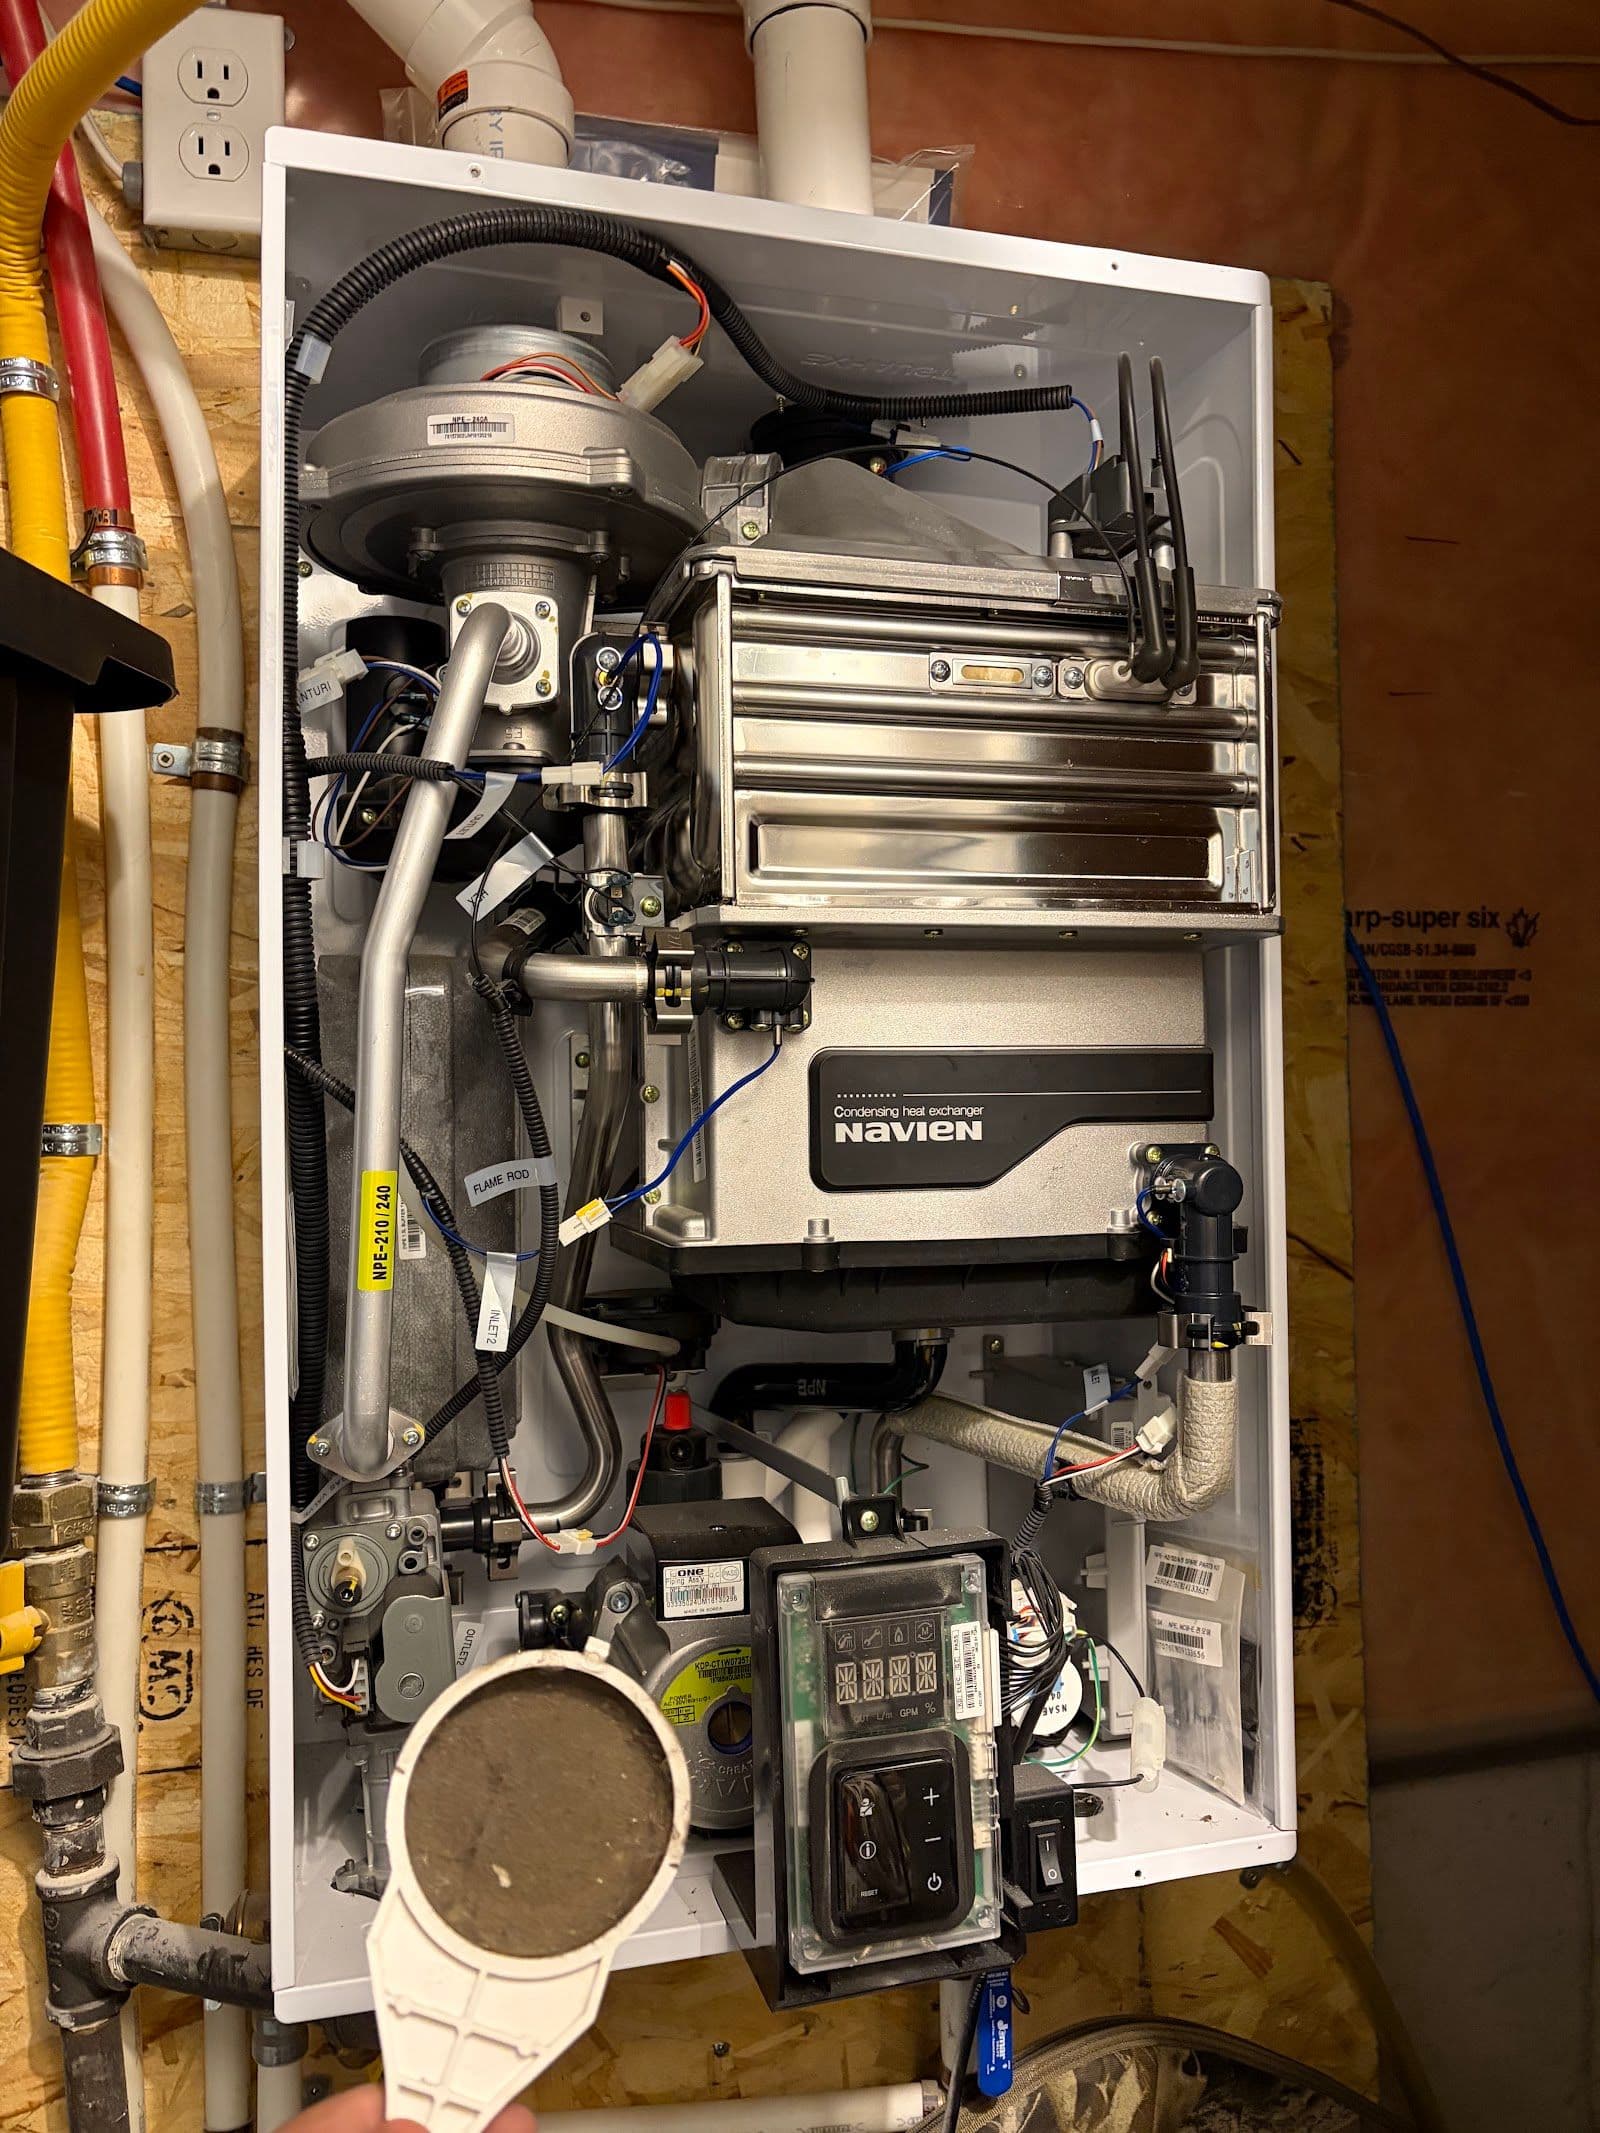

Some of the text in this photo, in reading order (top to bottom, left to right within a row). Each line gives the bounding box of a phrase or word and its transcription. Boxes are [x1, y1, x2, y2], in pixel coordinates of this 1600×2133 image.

[1467, 905, 1500, 929] six
[833, 1105, 985, 1119] Condensing heat exchanger
[473, 1169, 530, 1196] FLAME ROD
[486, 1309, 501, 1345] INLET2
[456, 1628, 476, 1666] OUTLET2
[899, 1707, 919, 1718] GPM
[924, 1702, 937, 1714] %
